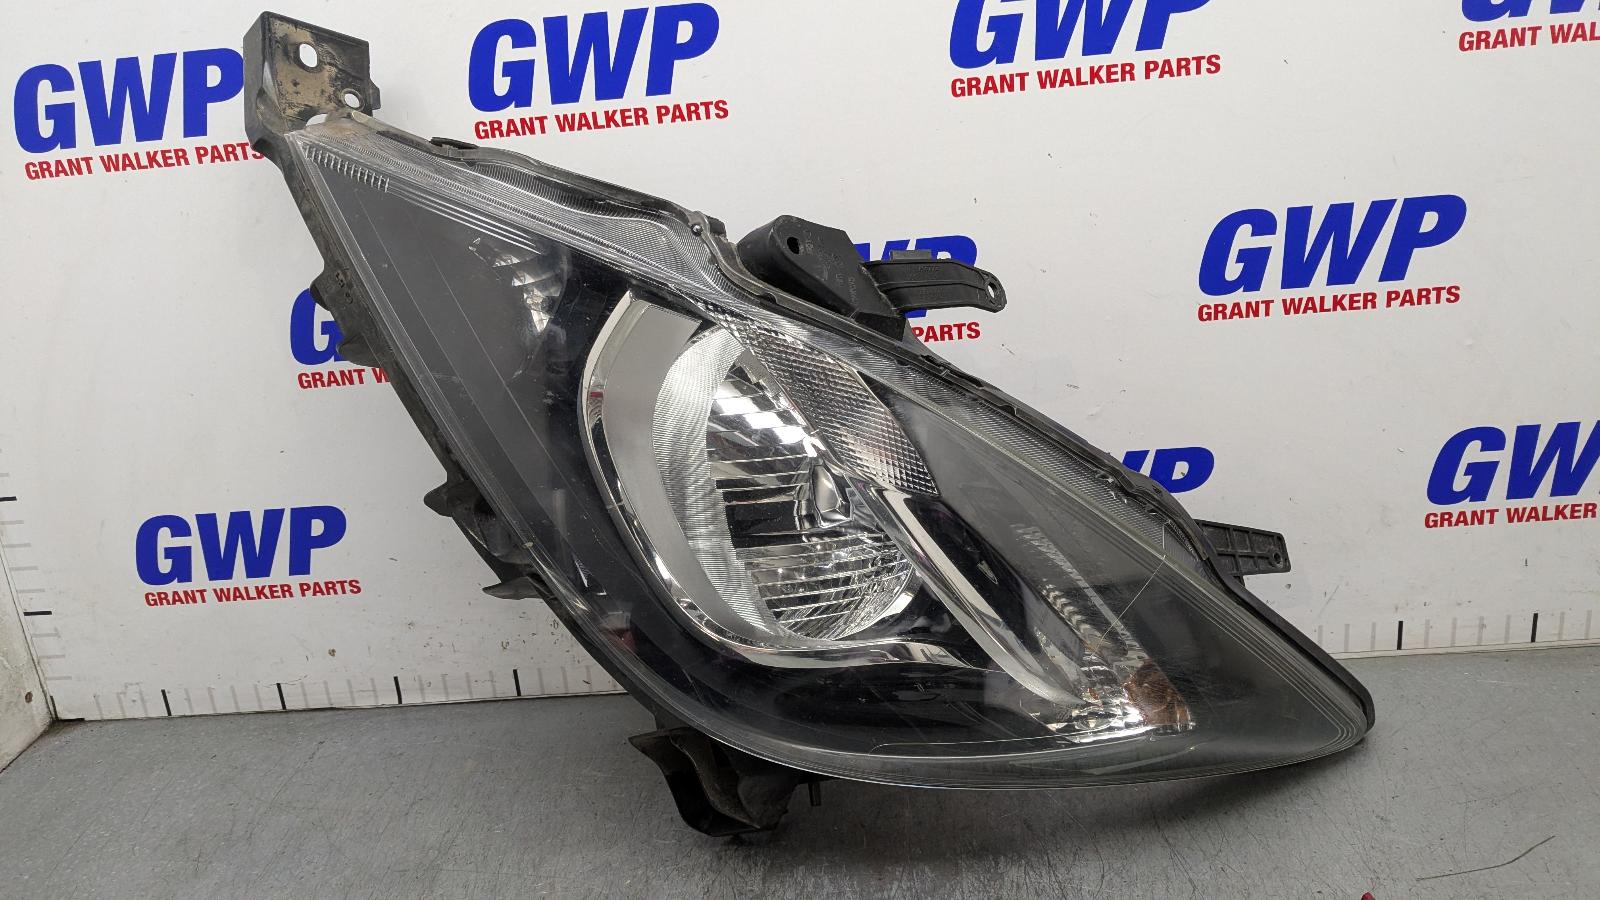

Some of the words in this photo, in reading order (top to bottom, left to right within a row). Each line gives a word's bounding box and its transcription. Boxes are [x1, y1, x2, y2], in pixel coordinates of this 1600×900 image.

[469, 2, 720, 112] GWP
[1458, 25, 1543, 52] GRANT
[1549, 21, 1600, 44] WAL
[950, 72, 1029, 98] GRANT
[1037, 62, 1136, 90] WALKER
[1144, 54, 1221, 80] PARTS
[13, 47, 244, 154] GWP
[474, 115, 548, 140] GRANT
[554, 107, 649, 133] WALKER
[656, 99, 729, 124] PARTS
[24, 156, 93, 180] GRANT
[99, 148, 190, 173] WALKER
[1198, 194, 1467, 296] GWP
[1197, 299, 1275, 322] GRANT
[1281, 292, 1377, 316] WALKER
[1385, 285, 1460, 309] PARTS
[297, 368, 366, 389] GRANT
[1426, 420, 1600, 506] GW
[1424, 508, 1499, 529] GRANT
[1506, 502, 1598, 524] WALKER
[135, 505, 347, 586] GWP
[144, 588, 207, 607] GRANT
[213, 583, 294, 603] WALKER
[298, 579, 362, 597] PARTS
